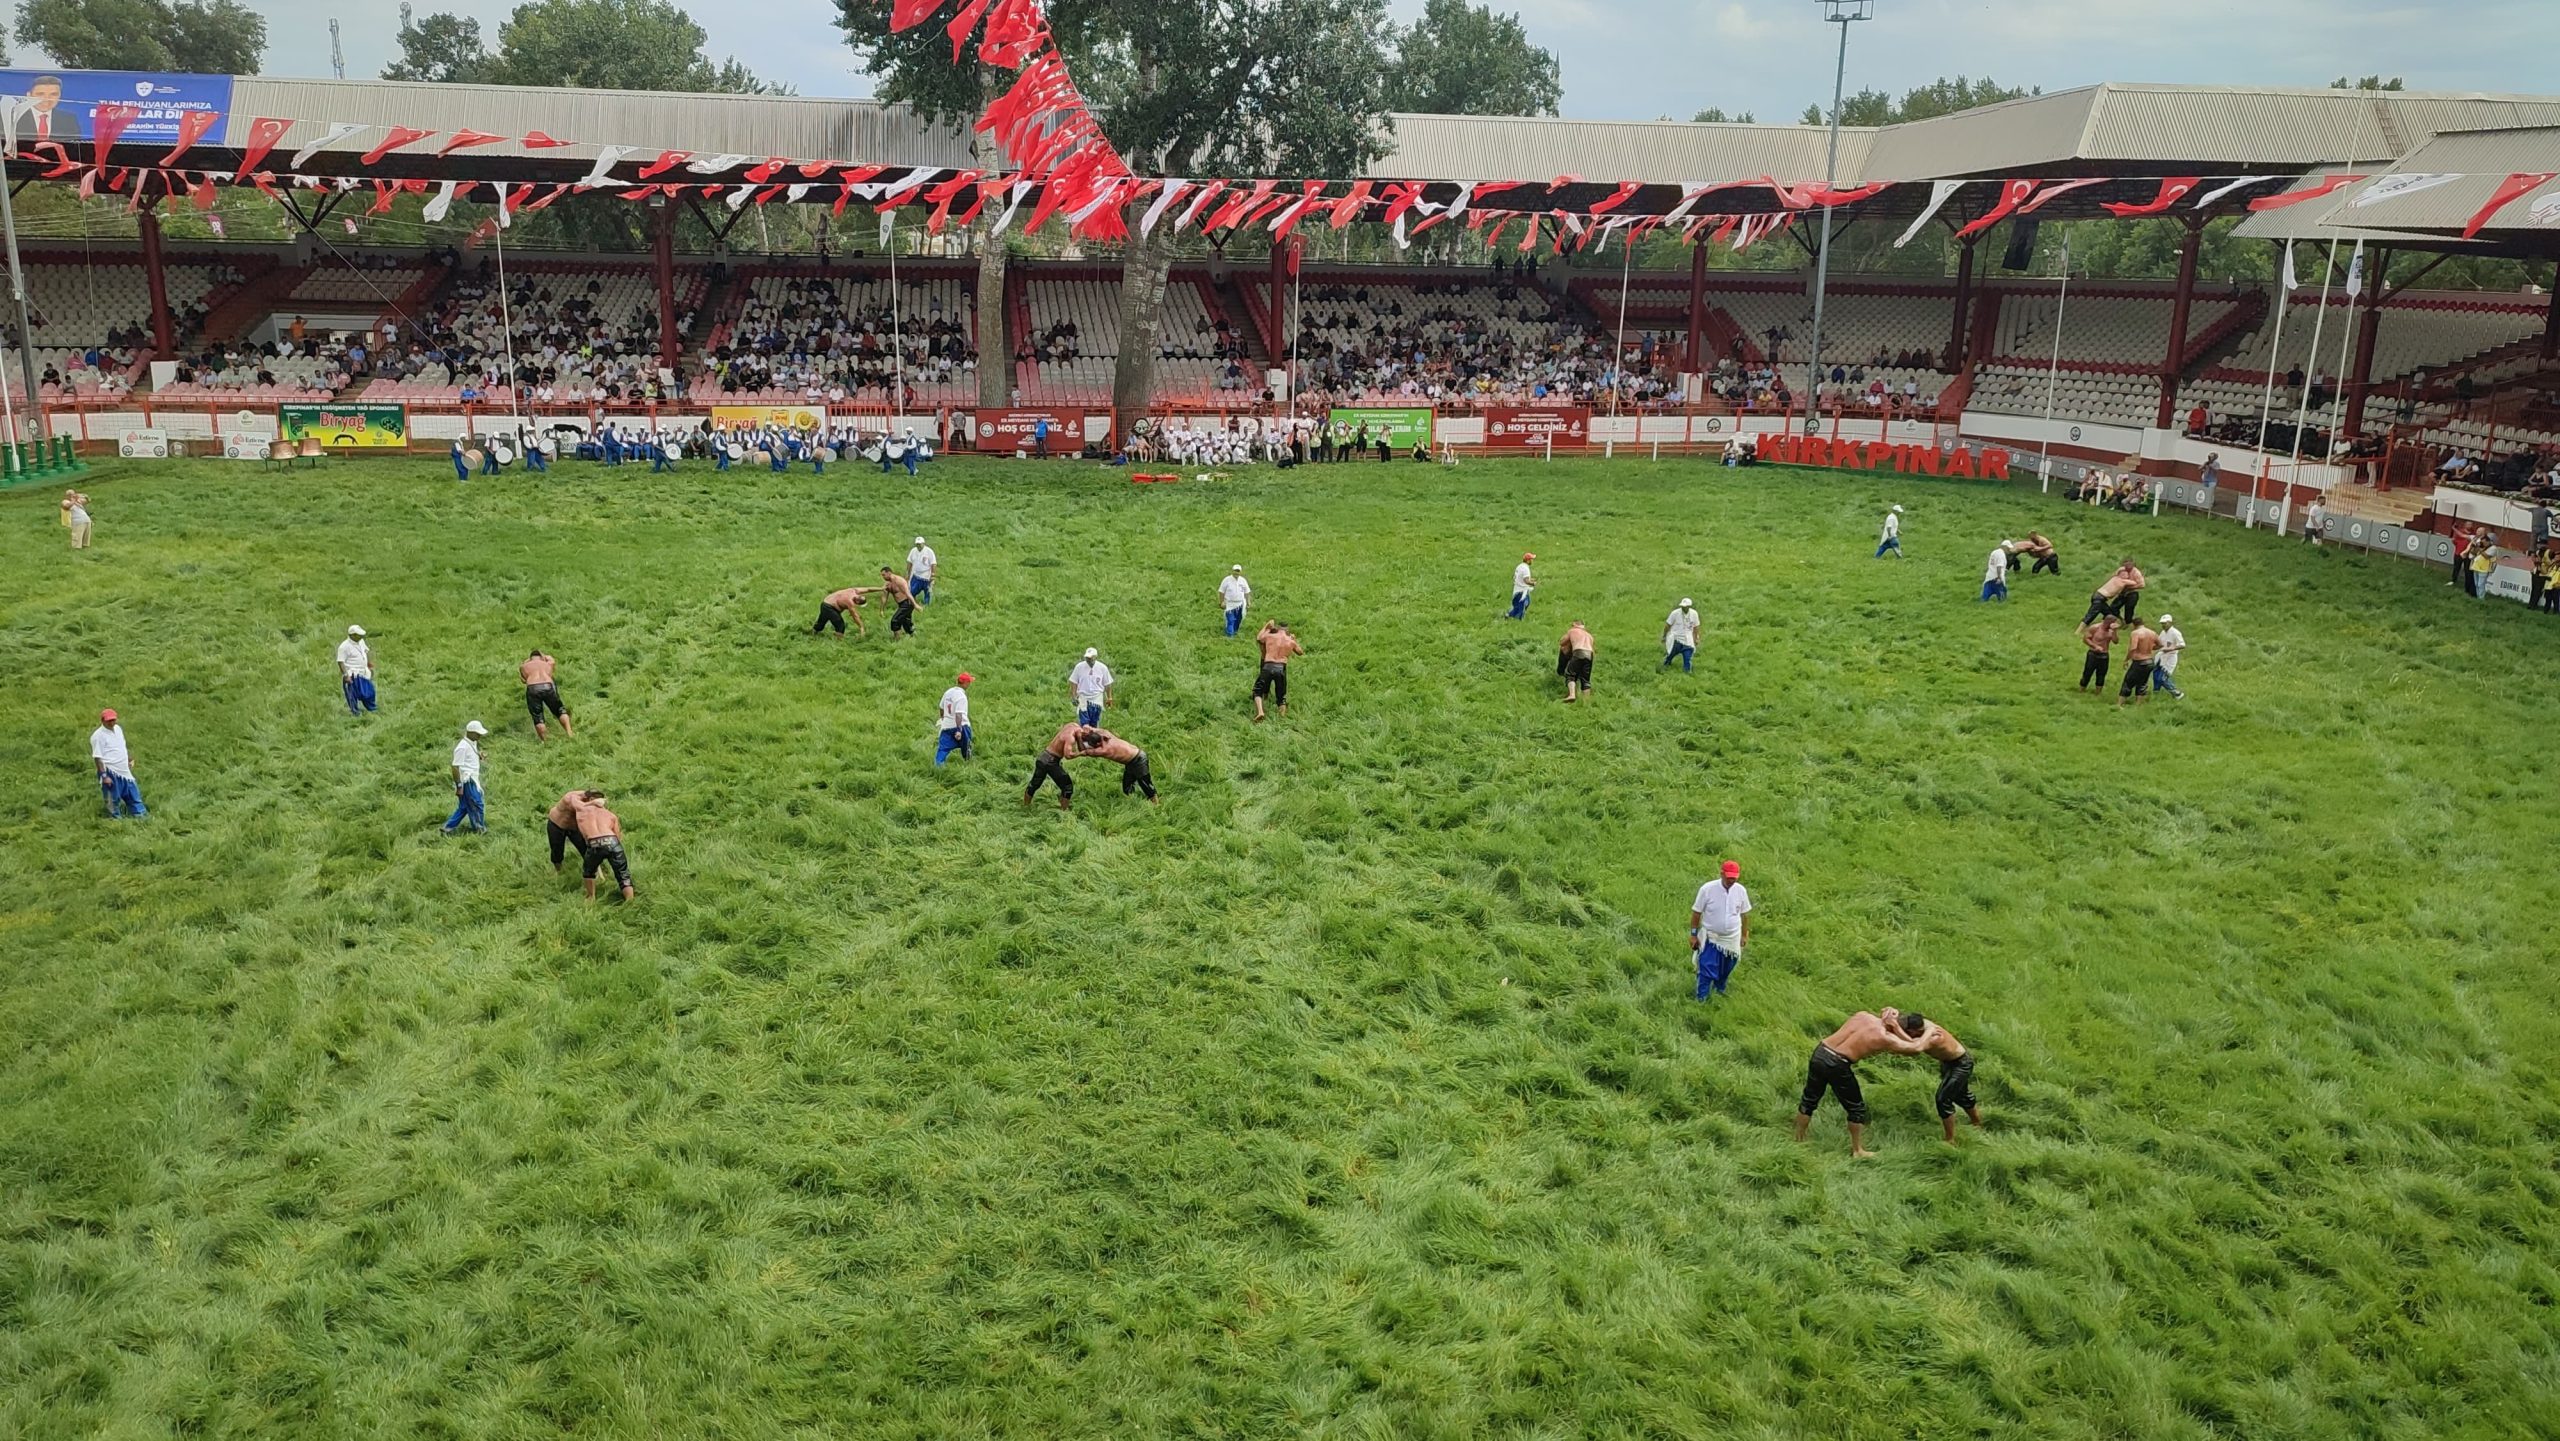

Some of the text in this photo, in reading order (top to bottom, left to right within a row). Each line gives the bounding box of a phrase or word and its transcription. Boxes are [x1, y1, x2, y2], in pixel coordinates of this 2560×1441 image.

[319, 411, 367, 433] Biryağ
[997, 422, 1063, 434] HOŞ GELNİZ
[1507, 421, 1568, 433] HOŞ GELDNİZ
[1755, 433, 2010, 481] KIRKPINAR
